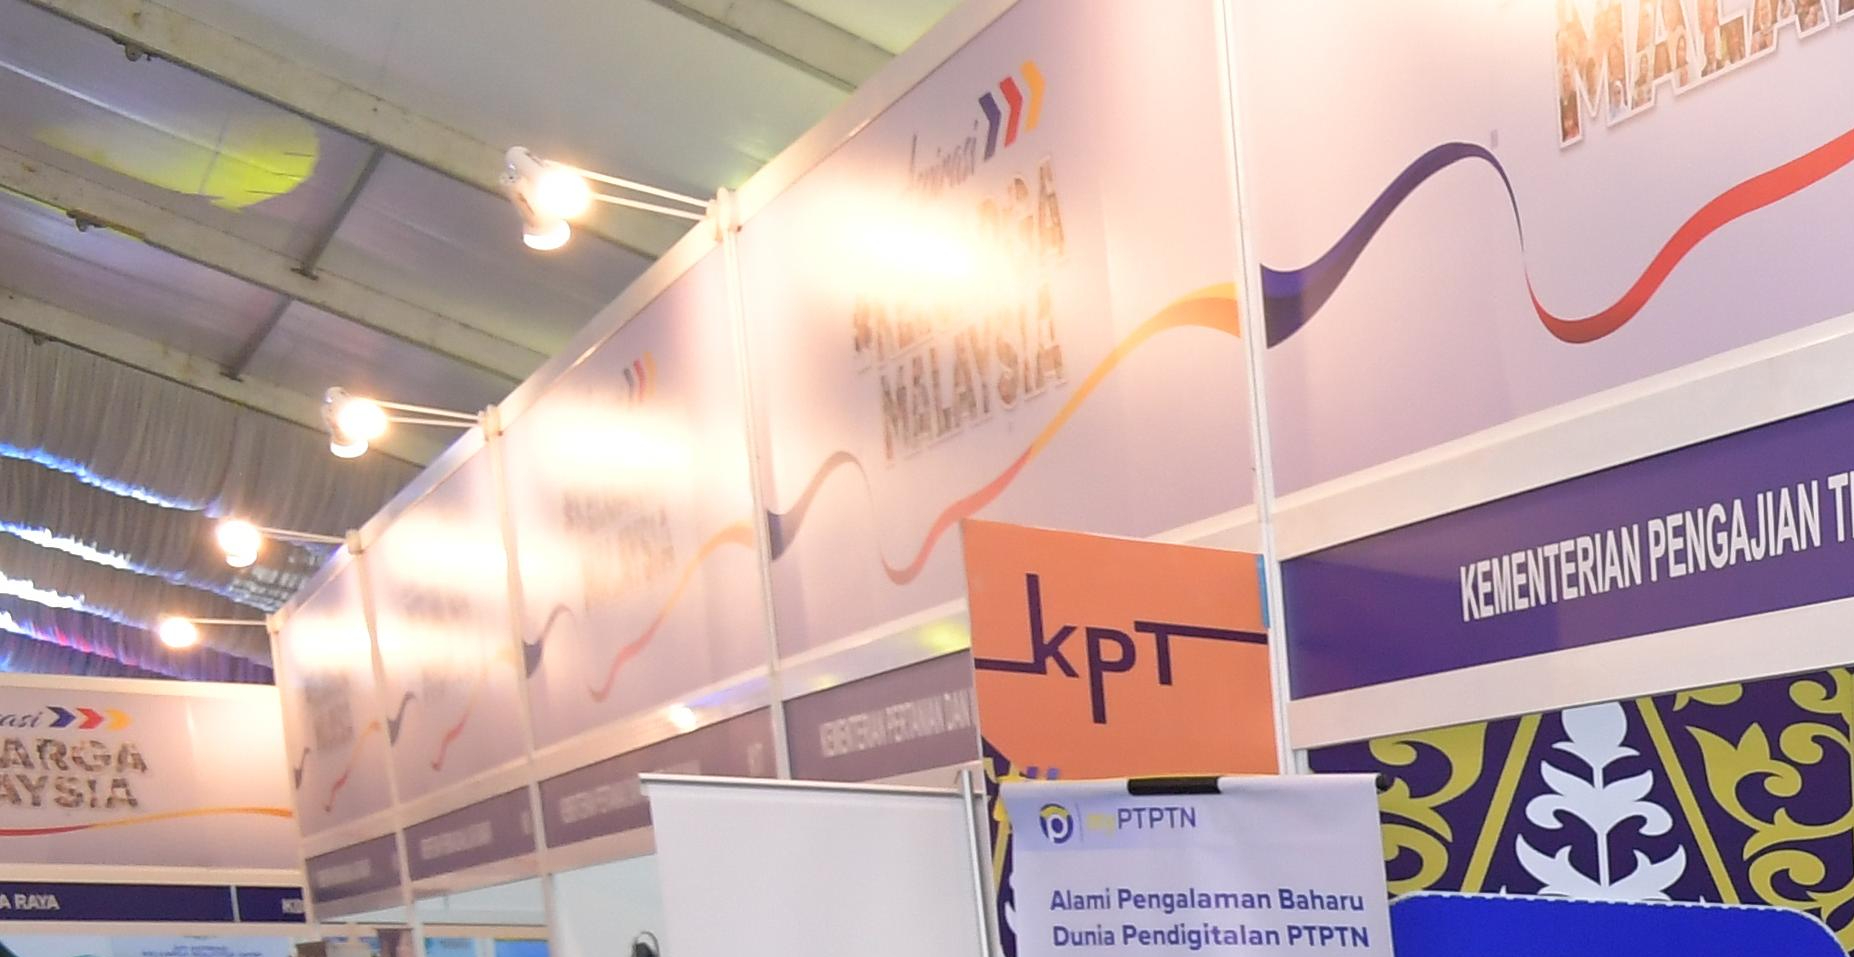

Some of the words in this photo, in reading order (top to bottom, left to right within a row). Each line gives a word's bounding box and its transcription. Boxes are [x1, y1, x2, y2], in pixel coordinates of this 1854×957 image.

[1460, 523, 1643, 622] KEMENTERIAN
[1647, 480, 1821, 582] PENGAJIAN
[15, 894, 60, 910] RAYA
[1050, 888, 1111, 912] Alami
[1118, 888, 1272, 914] Pengalaman
[1278, 888, 1365, 912] Baharu
[1053, 925, 1116, 947] Dunia
[1122, 924, 1280, 951] Pendigitalan
[1286, 925, 1370, 949] PTPTN
